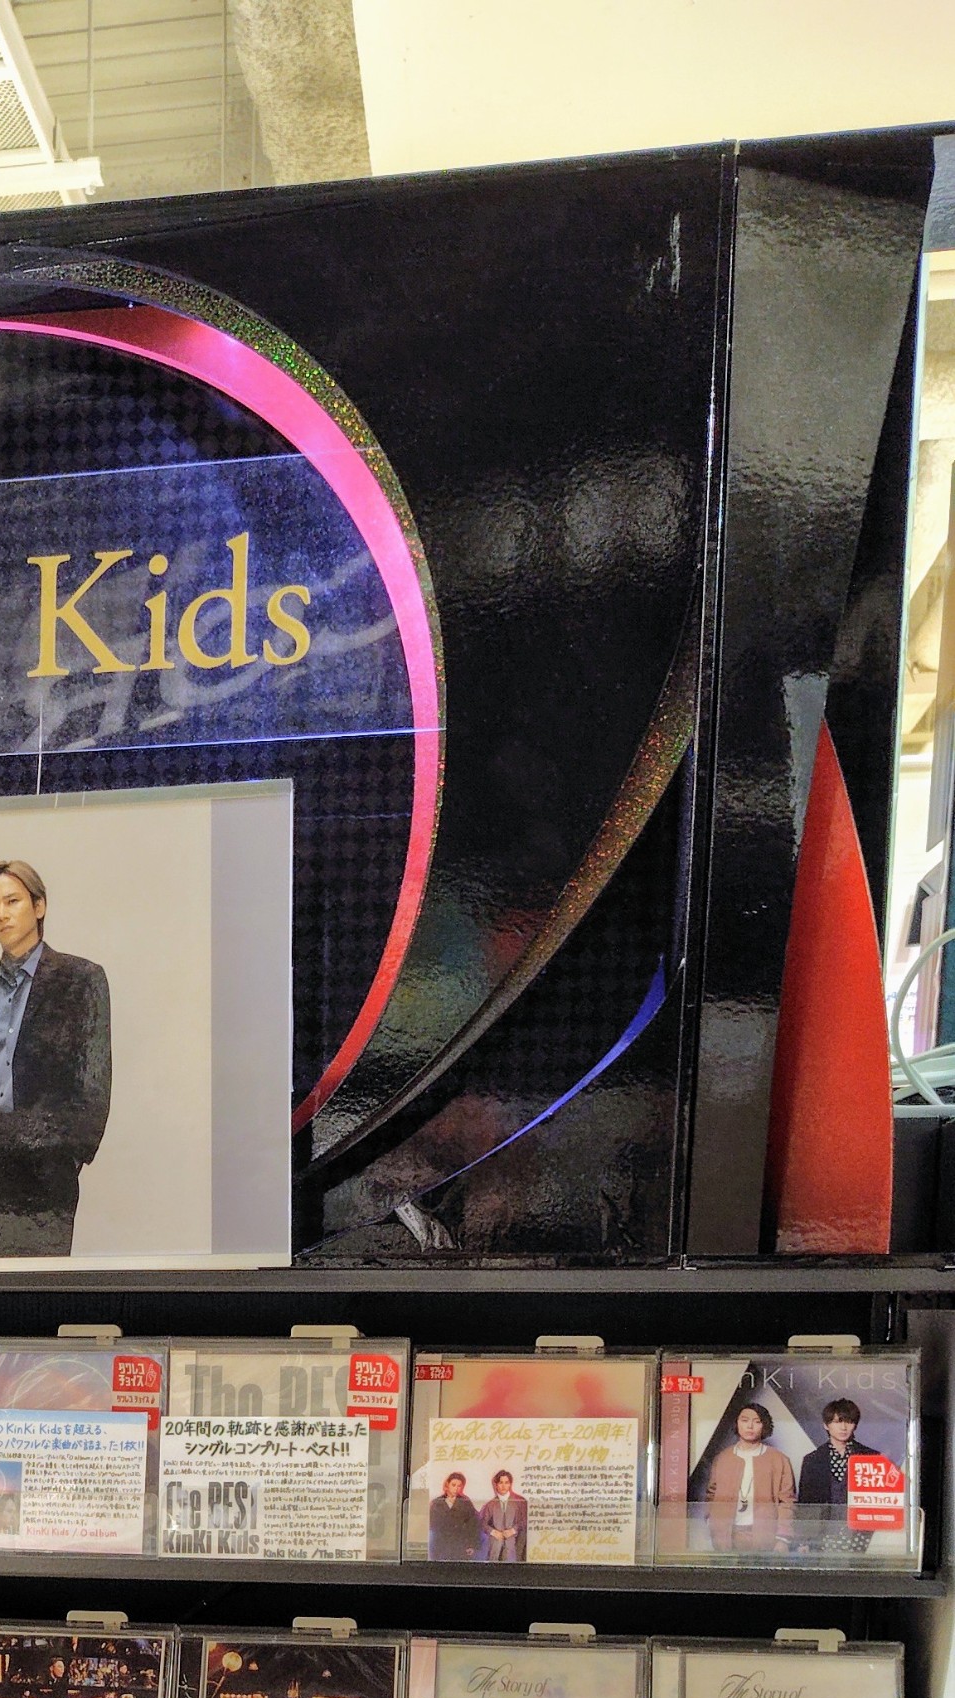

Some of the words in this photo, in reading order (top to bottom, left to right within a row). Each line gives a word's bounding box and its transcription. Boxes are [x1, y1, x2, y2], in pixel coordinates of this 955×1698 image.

[26, 532, 312, 678] Kids
[119, 1363, 144, 1375] タワレコ
[356, 1362, 383, 1374] タワレコ
[118, 1376, 144, 1387] チョイス
[356, 1375, 381, 1386] チョイス
[165, 1420, 367, 1438] 20年間の軌跡と感謝が詰まった
[854, 1463, 885, 1476] タワレコ
[854, 1476, 885, 1488] チョイス
[26, 1528, 50, 1536] KinKi
[51, 1528, 69, 1536] Kids
[163, 1530, 212, 1554] KinKi
[218, 1530, 260, 1555] Kids
[264, 1549, 285, 1559] KinKi
[288, 1549, 307, 1559] Kids
[497, 1676, 533, 1696] Story
[534, 1677, 549, 1697] of
